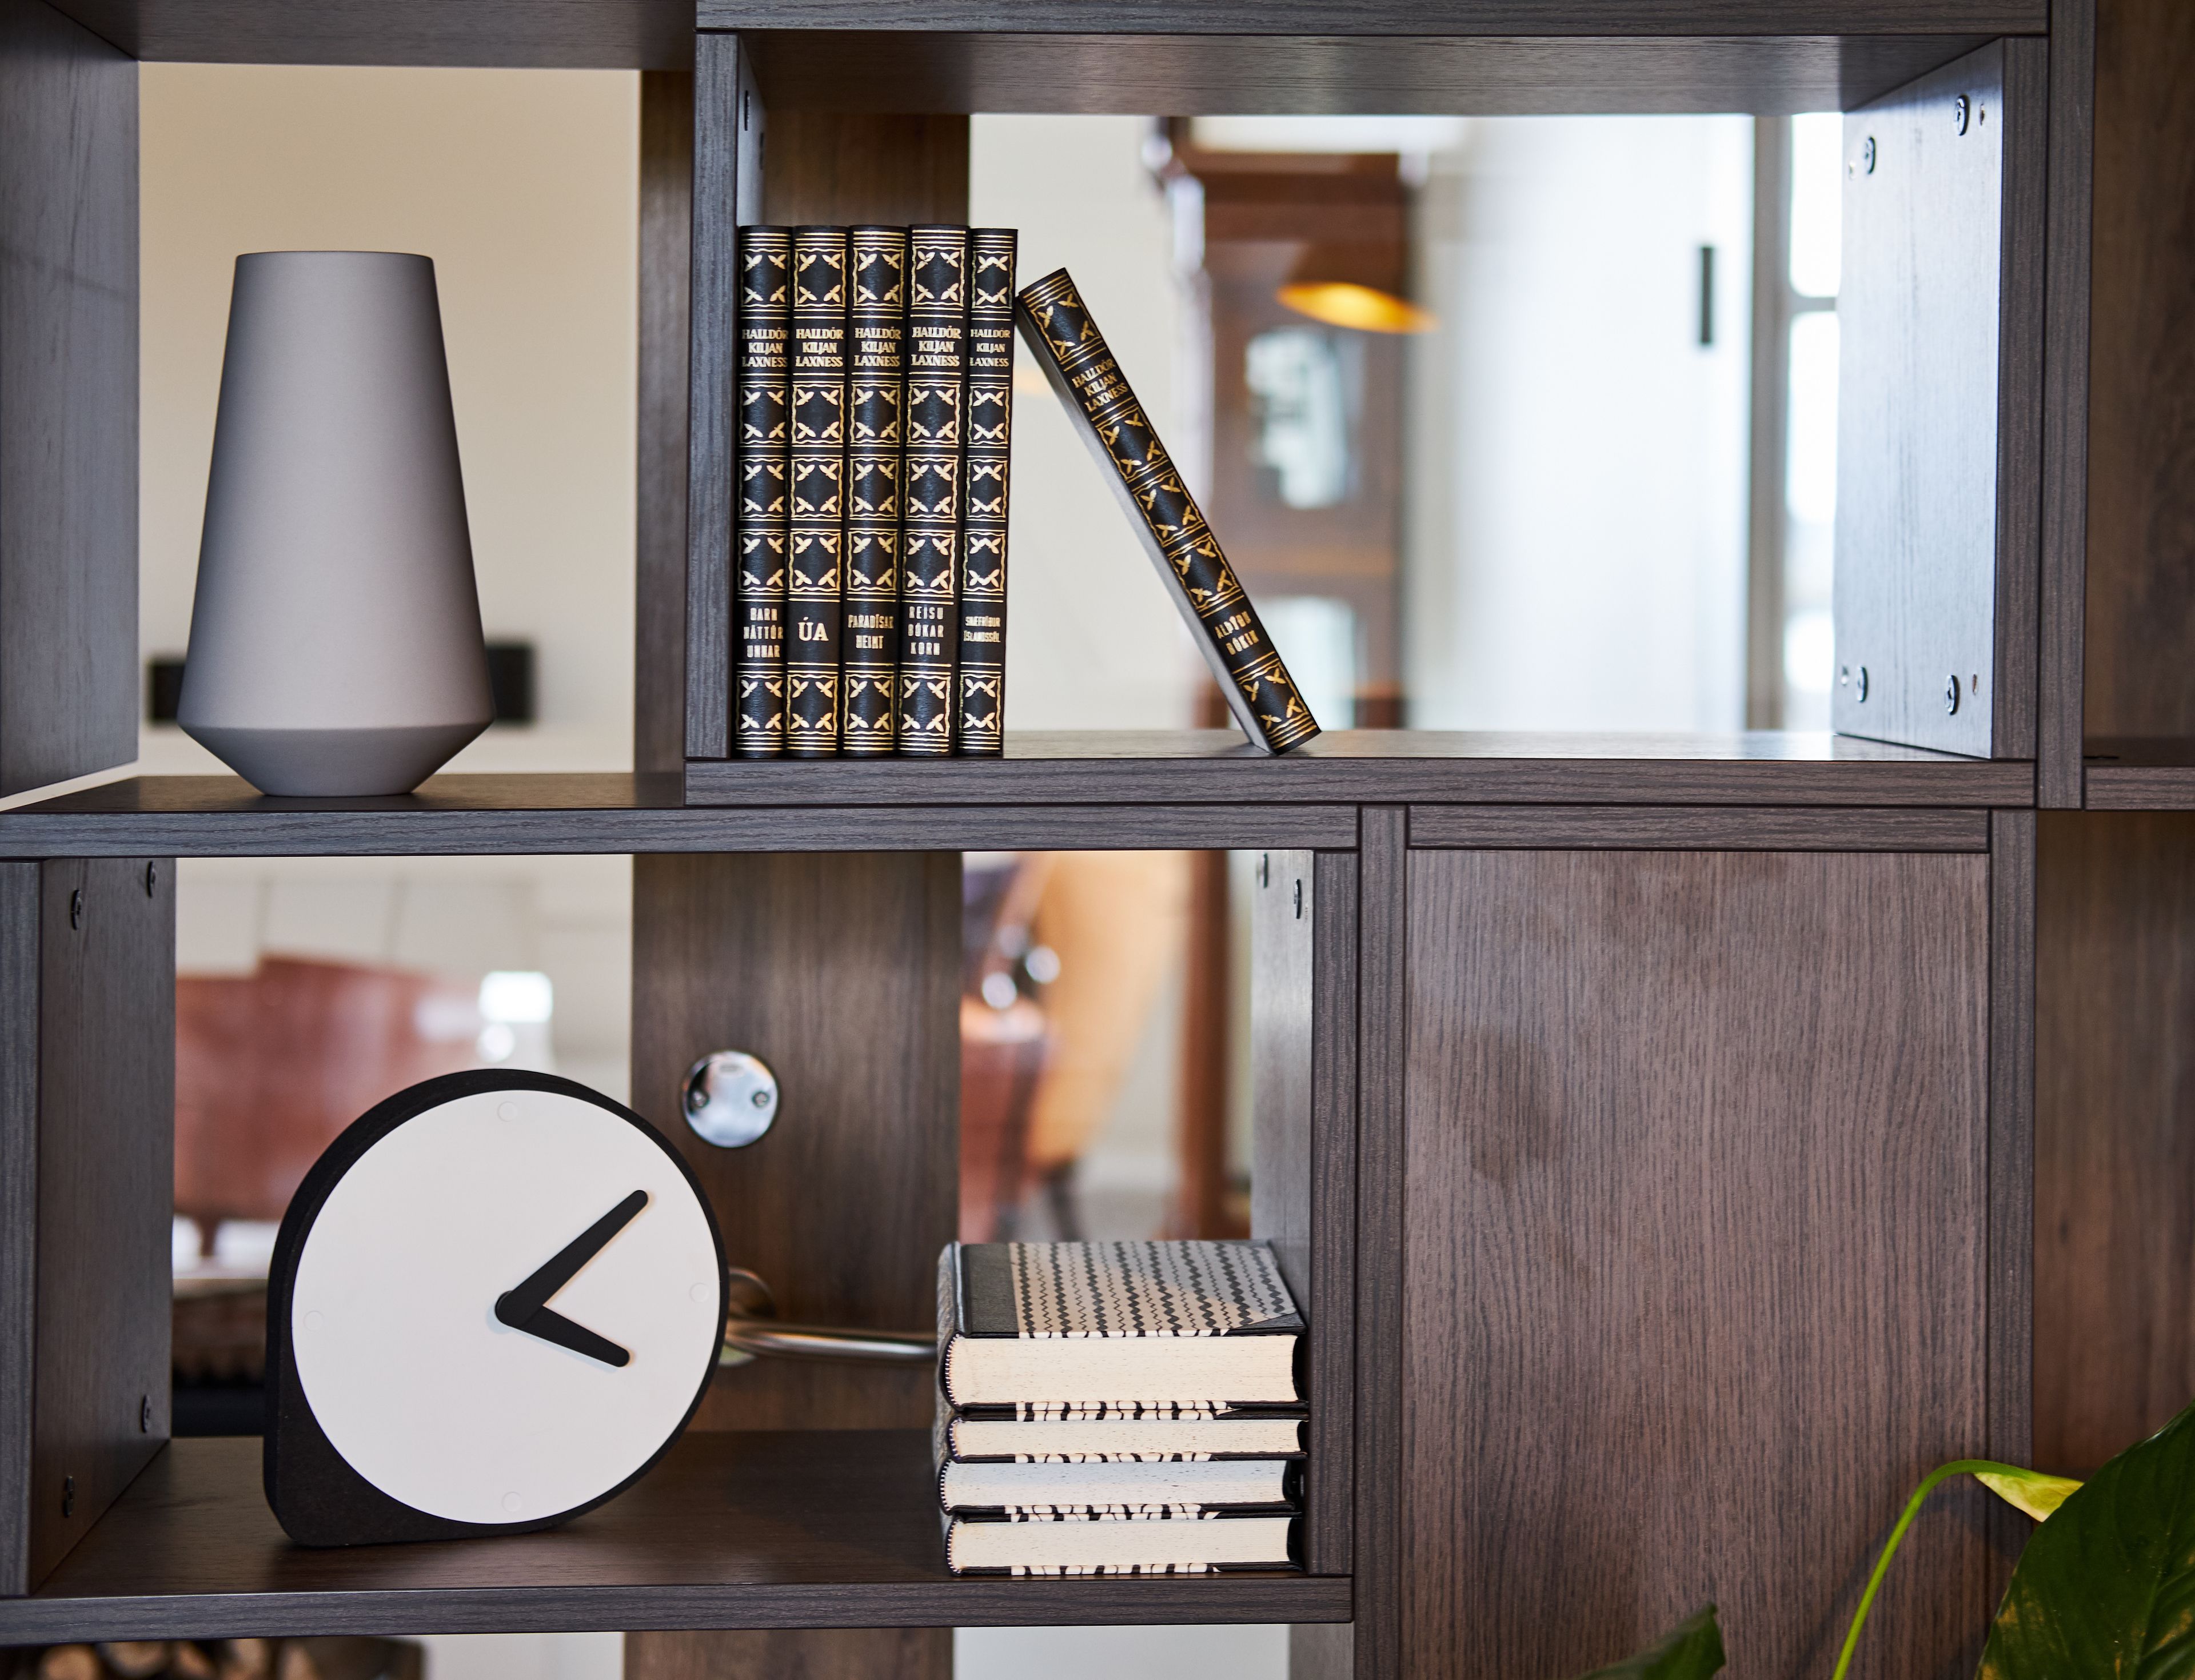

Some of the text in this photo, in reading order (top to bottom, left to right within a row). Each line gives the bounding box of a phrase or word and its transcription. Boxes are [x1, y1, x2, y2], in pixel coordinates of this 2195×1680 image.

[742, 328, 788, 339] HALLDÓR
[796, 327, 844, 339] HALLDÓR
[855, 326, 901, 339] HALLDÓR
[912, 325, 961, 338] HALLDÓR
[971, 328, 1010, 338] HALLDÓR
[748, 342, 783, 354] KILJAN
[803, 342, 837, 354] KILJAN
[861, 341, 896, 354] KILJAN
[918, 340, 955, 354] KILJAN
[976, 343, 1005, 353] KILJAN
[742, 356, 788, 367] LAXNESS
[796, 356, 843, 367] LAXNESS
[854, 355, 900, 366] LAXNESS
[911, 354, 960, 366] LAXNESS
[969, 357, 1009, 366] LAXNESS
[1072, 359, 1116, 388] HALLDÓR
[1084, 373, 1117, 397] KILJAN
[1084, 383, 1128, 412] LAXNESS
[909, 606, 943, 619] REISU
[797, 617, 829, 641] ÚA
